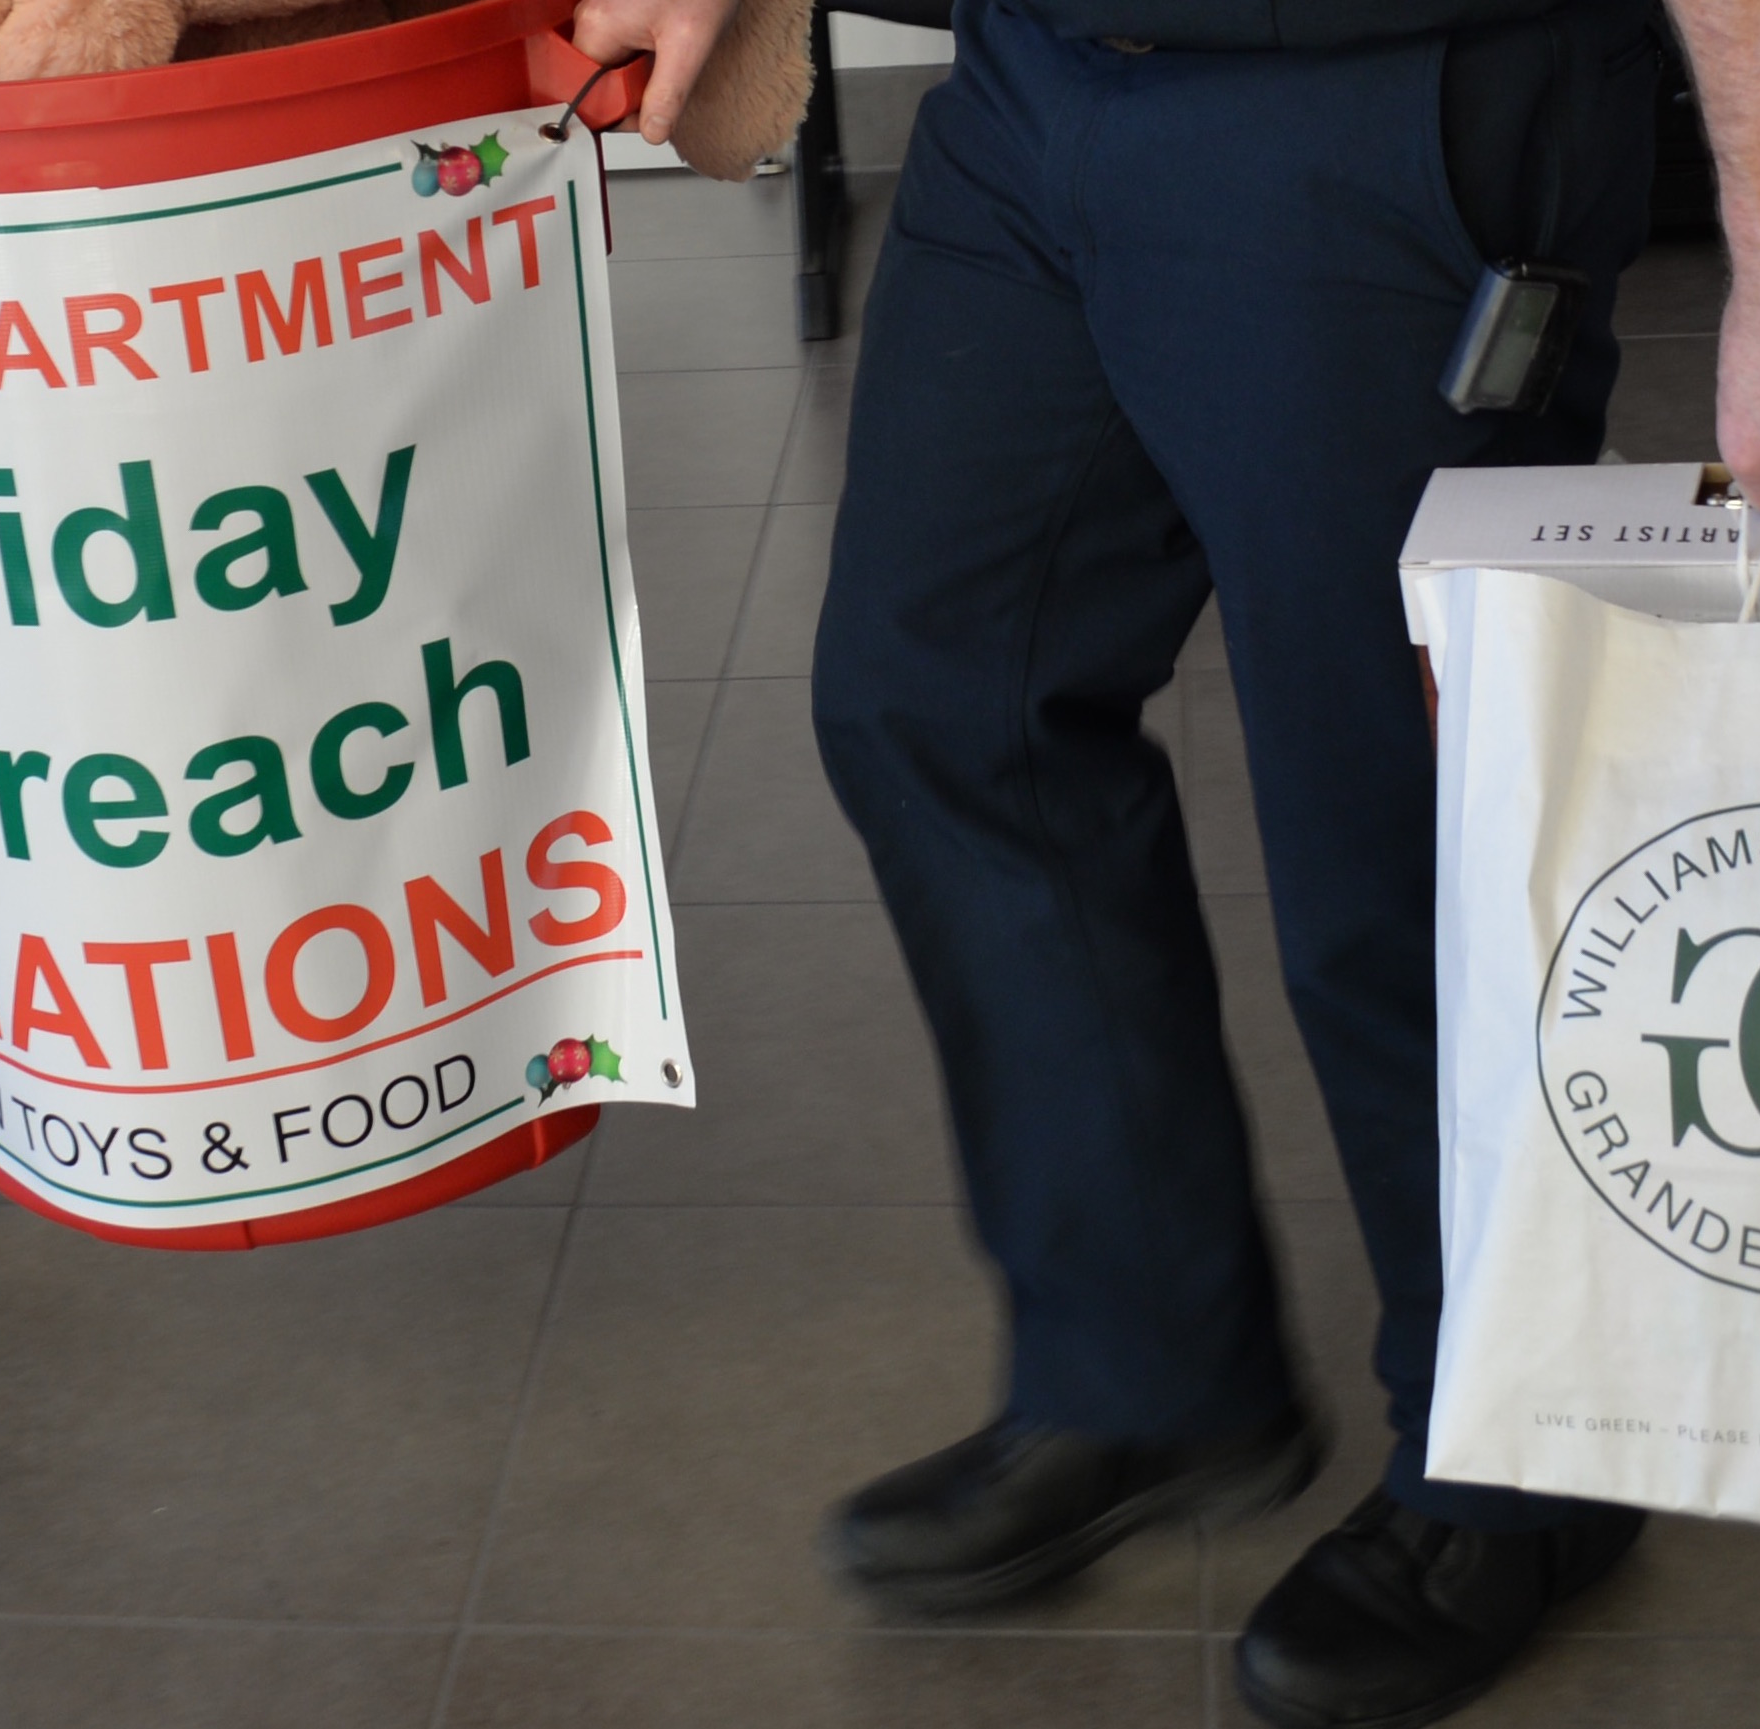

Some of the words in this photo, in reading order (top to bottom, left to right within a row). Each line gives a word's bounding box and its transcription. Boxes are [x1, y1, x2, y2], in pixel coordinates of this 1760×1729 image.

[1532, 522, 1596, 544] SET
[1614, 523, 1741, 547] ARTIST
[12, 1095, 174, 1181] TOYS
[199, 1120, 251, 1176] &
[272, 1052, 479, 1164] FOOD
[1534, 1412, 1577, 1430] LIVE
[1585, 1417, 1651, 1434] GREEN
[1677, 1426, 1750, 1445] PLEASE
